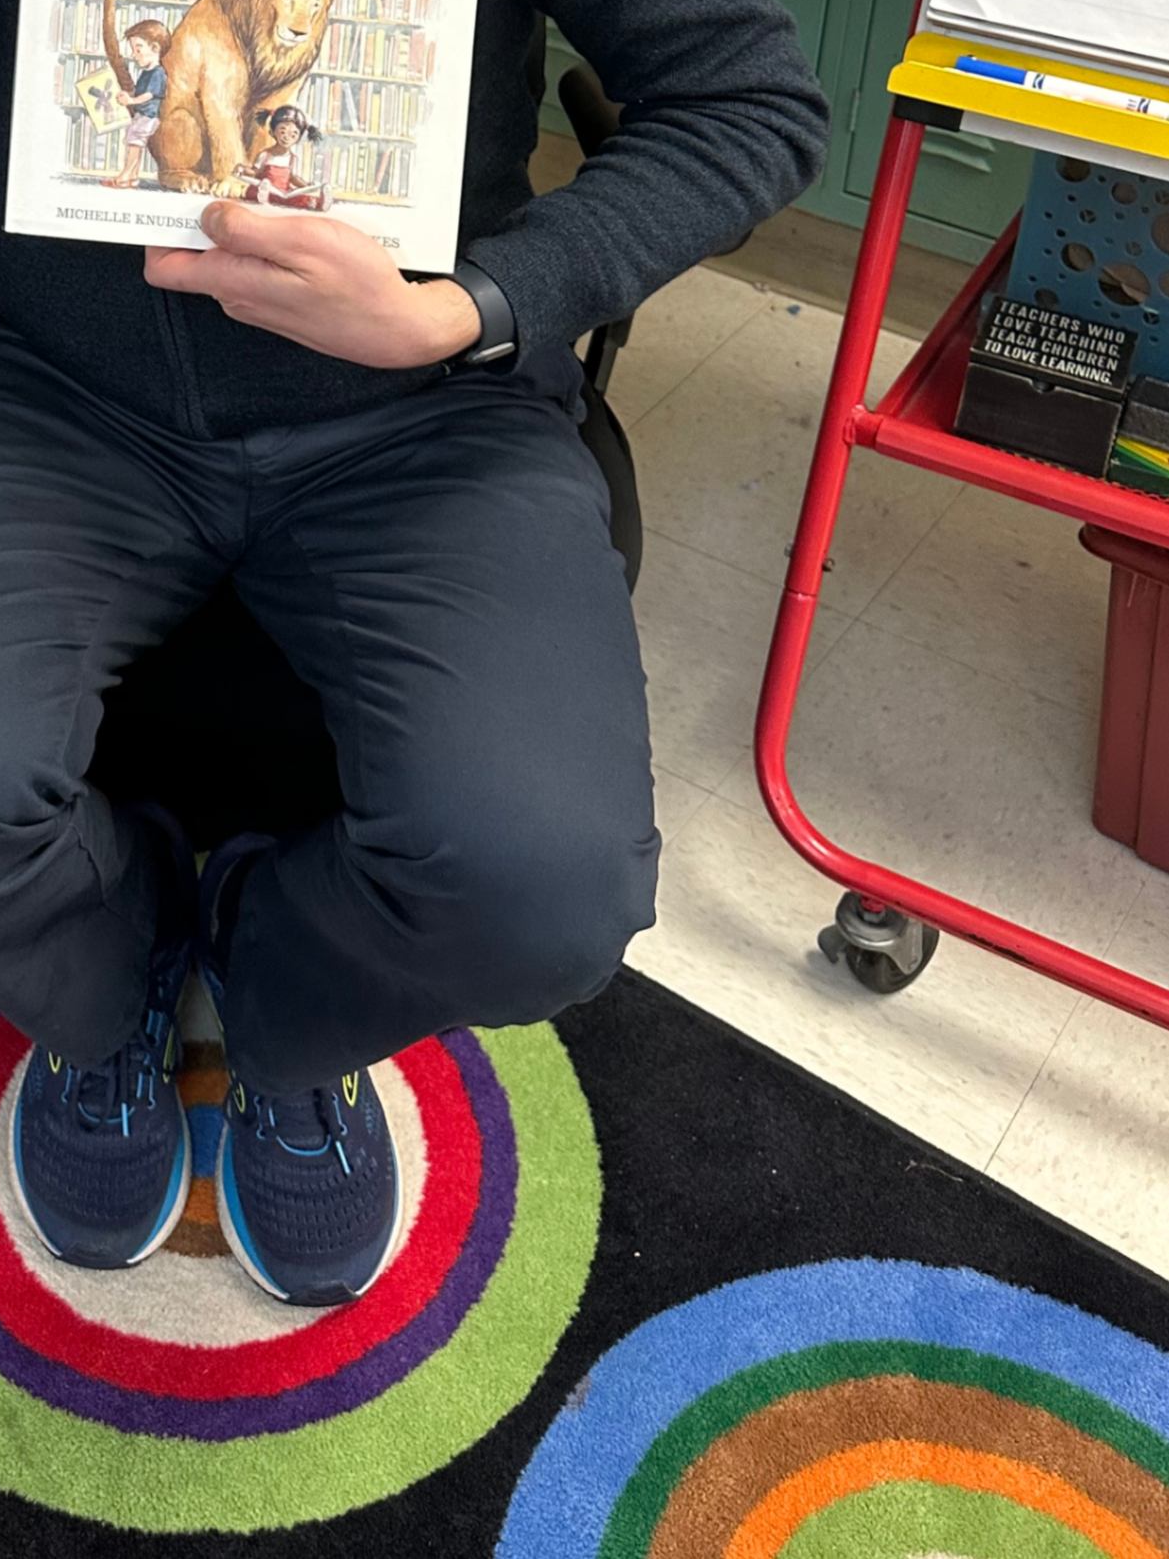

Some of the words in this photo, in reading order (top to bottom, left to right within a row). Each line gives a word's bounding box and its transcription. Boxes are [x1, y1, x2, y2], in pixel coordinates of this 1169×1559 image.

[56, 207, 131, 224] MICHELLE
[993, 313, 1036, 335] LOVE
[1039, 325, 1121, 359] TEACHING.
[1000, 300, 1081, 332] TEACHERS
[1088, 323, 1126, 344] WHO
[984, 339, 1002, 353] TO
[1003, 345, 1039, 364] LOVE
[1040, 355, 1112, 386] LEARNING.
[989, 326, 1037, 349] TEACH
[1041, 340, 1119, 372] CHILDREN
